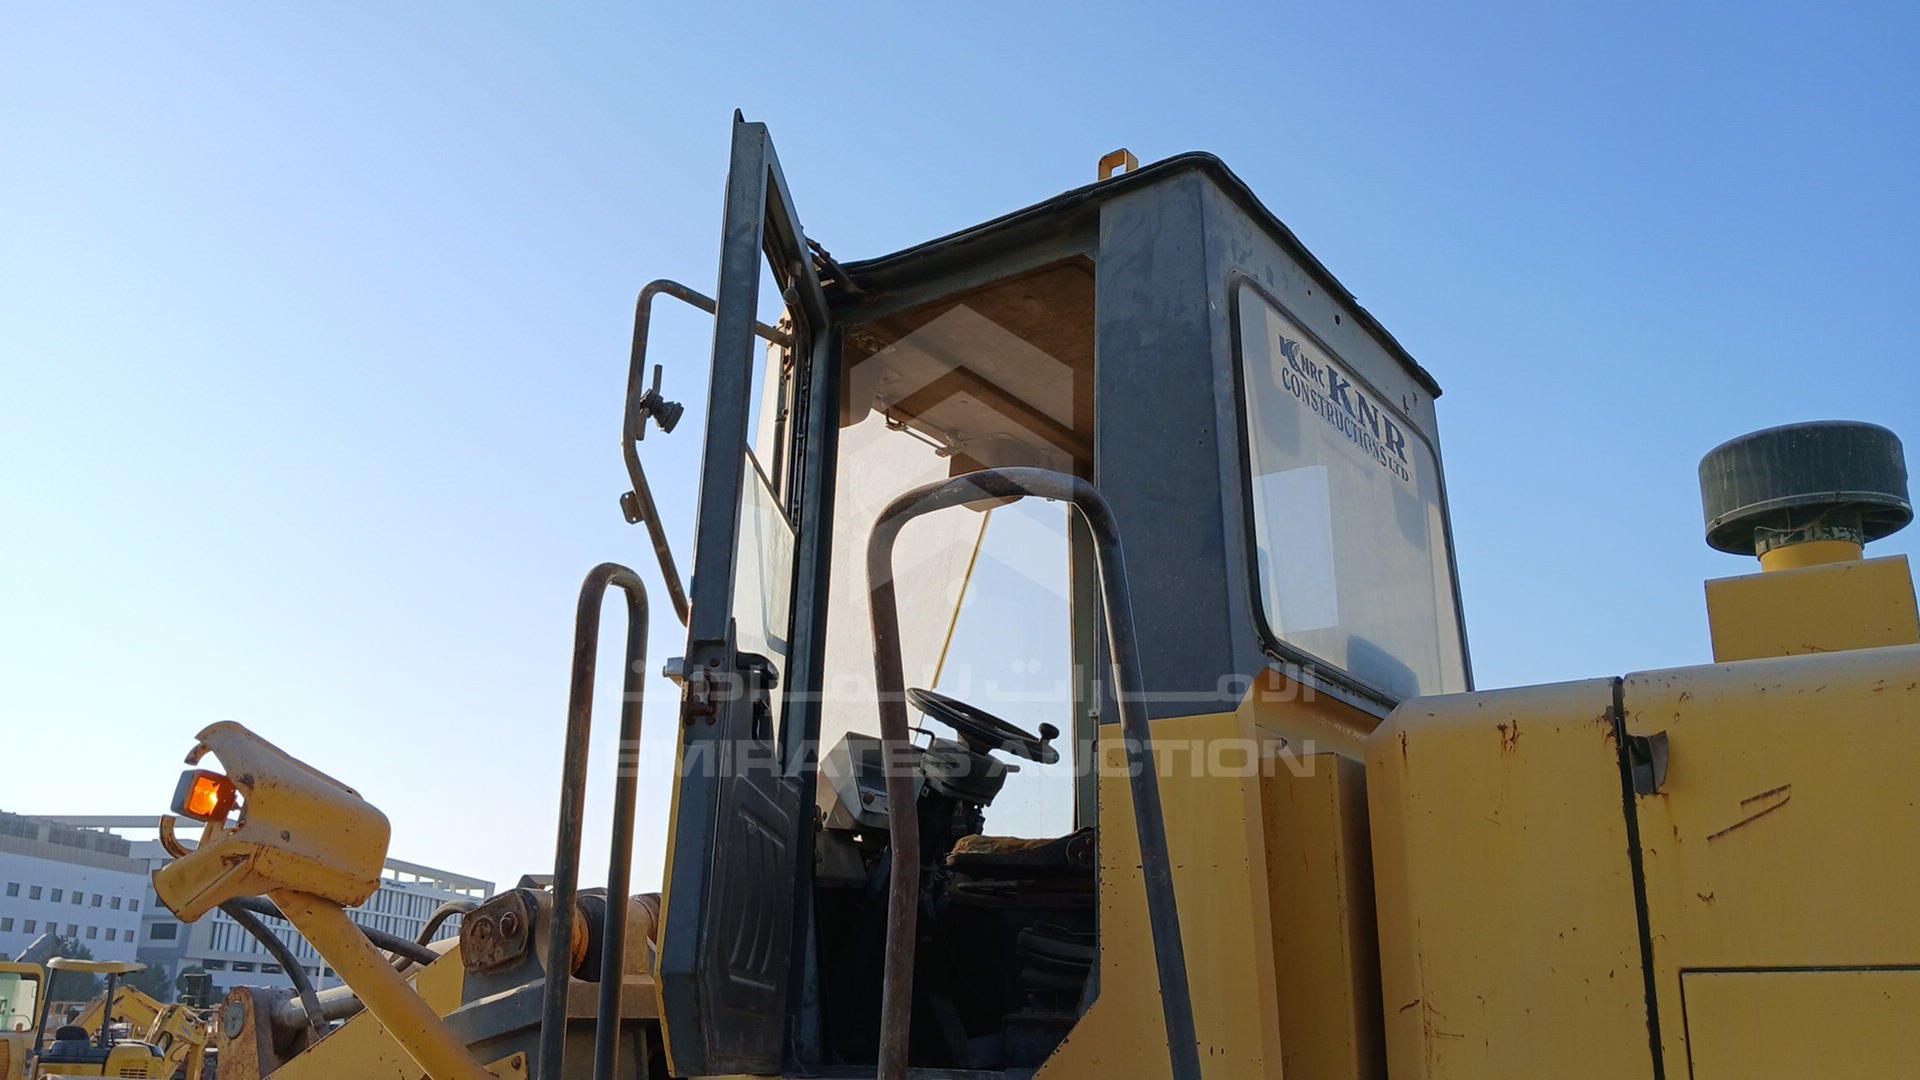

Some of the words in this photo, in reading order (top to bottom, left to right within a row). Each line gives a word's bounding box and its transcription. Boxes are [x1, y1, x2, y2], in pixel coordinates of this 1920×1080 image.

[1282, 367, 1387, 466] CONSTRUCTIONS
[1388, 457, 1409, 482] LTD
[1326, 364, 1408, 464] KNR
